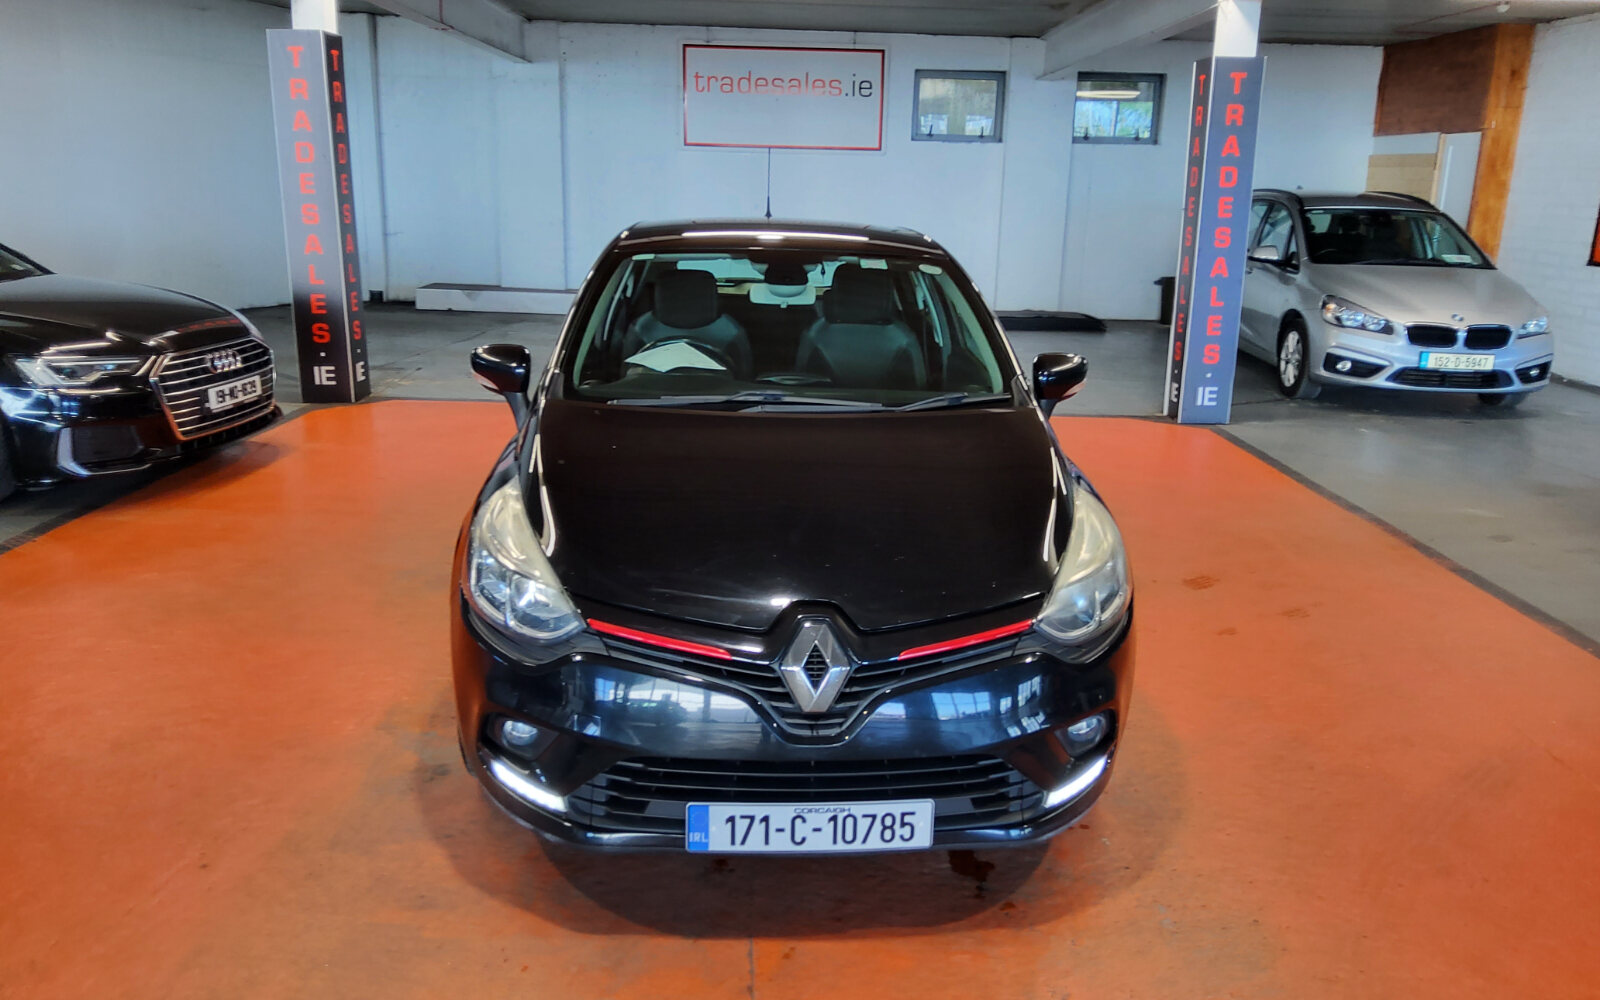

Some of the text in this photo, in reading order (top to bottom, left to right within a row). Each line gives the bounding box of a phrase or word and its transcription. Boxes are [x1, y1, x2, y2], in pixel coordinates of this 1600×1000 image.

[693, 70, 873, 98] tradesales.ie
[689, 832, 709, 843] IRL
[725, 812, 917, 846] 171-C-10785
